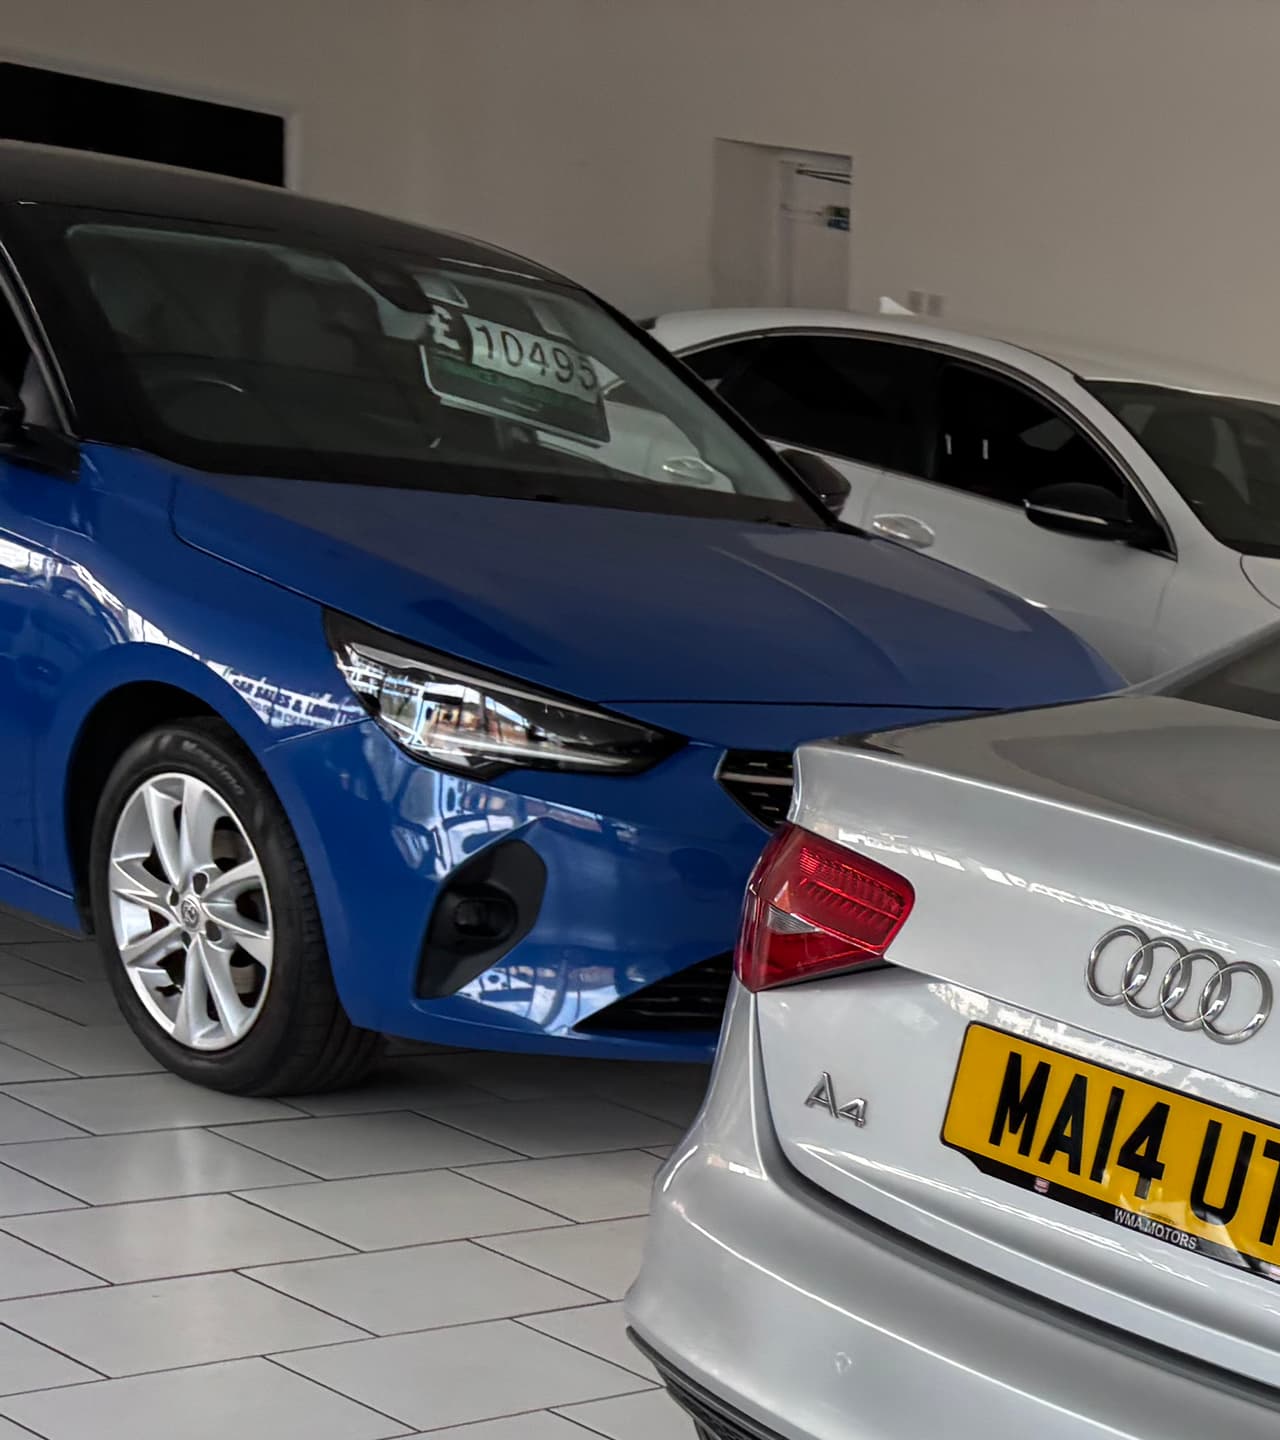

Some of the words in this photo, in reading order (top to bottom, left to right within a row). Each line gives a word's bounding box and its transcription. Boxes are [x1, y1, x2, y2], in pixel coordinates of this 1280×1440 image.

[803, 1071, 869, 1129] A4
[988, 1051, 1171, 1200] MA14
[1114, 1208, 1143, 1231] WMA
[1143, 1221, 1198, 1250] MOTORS
